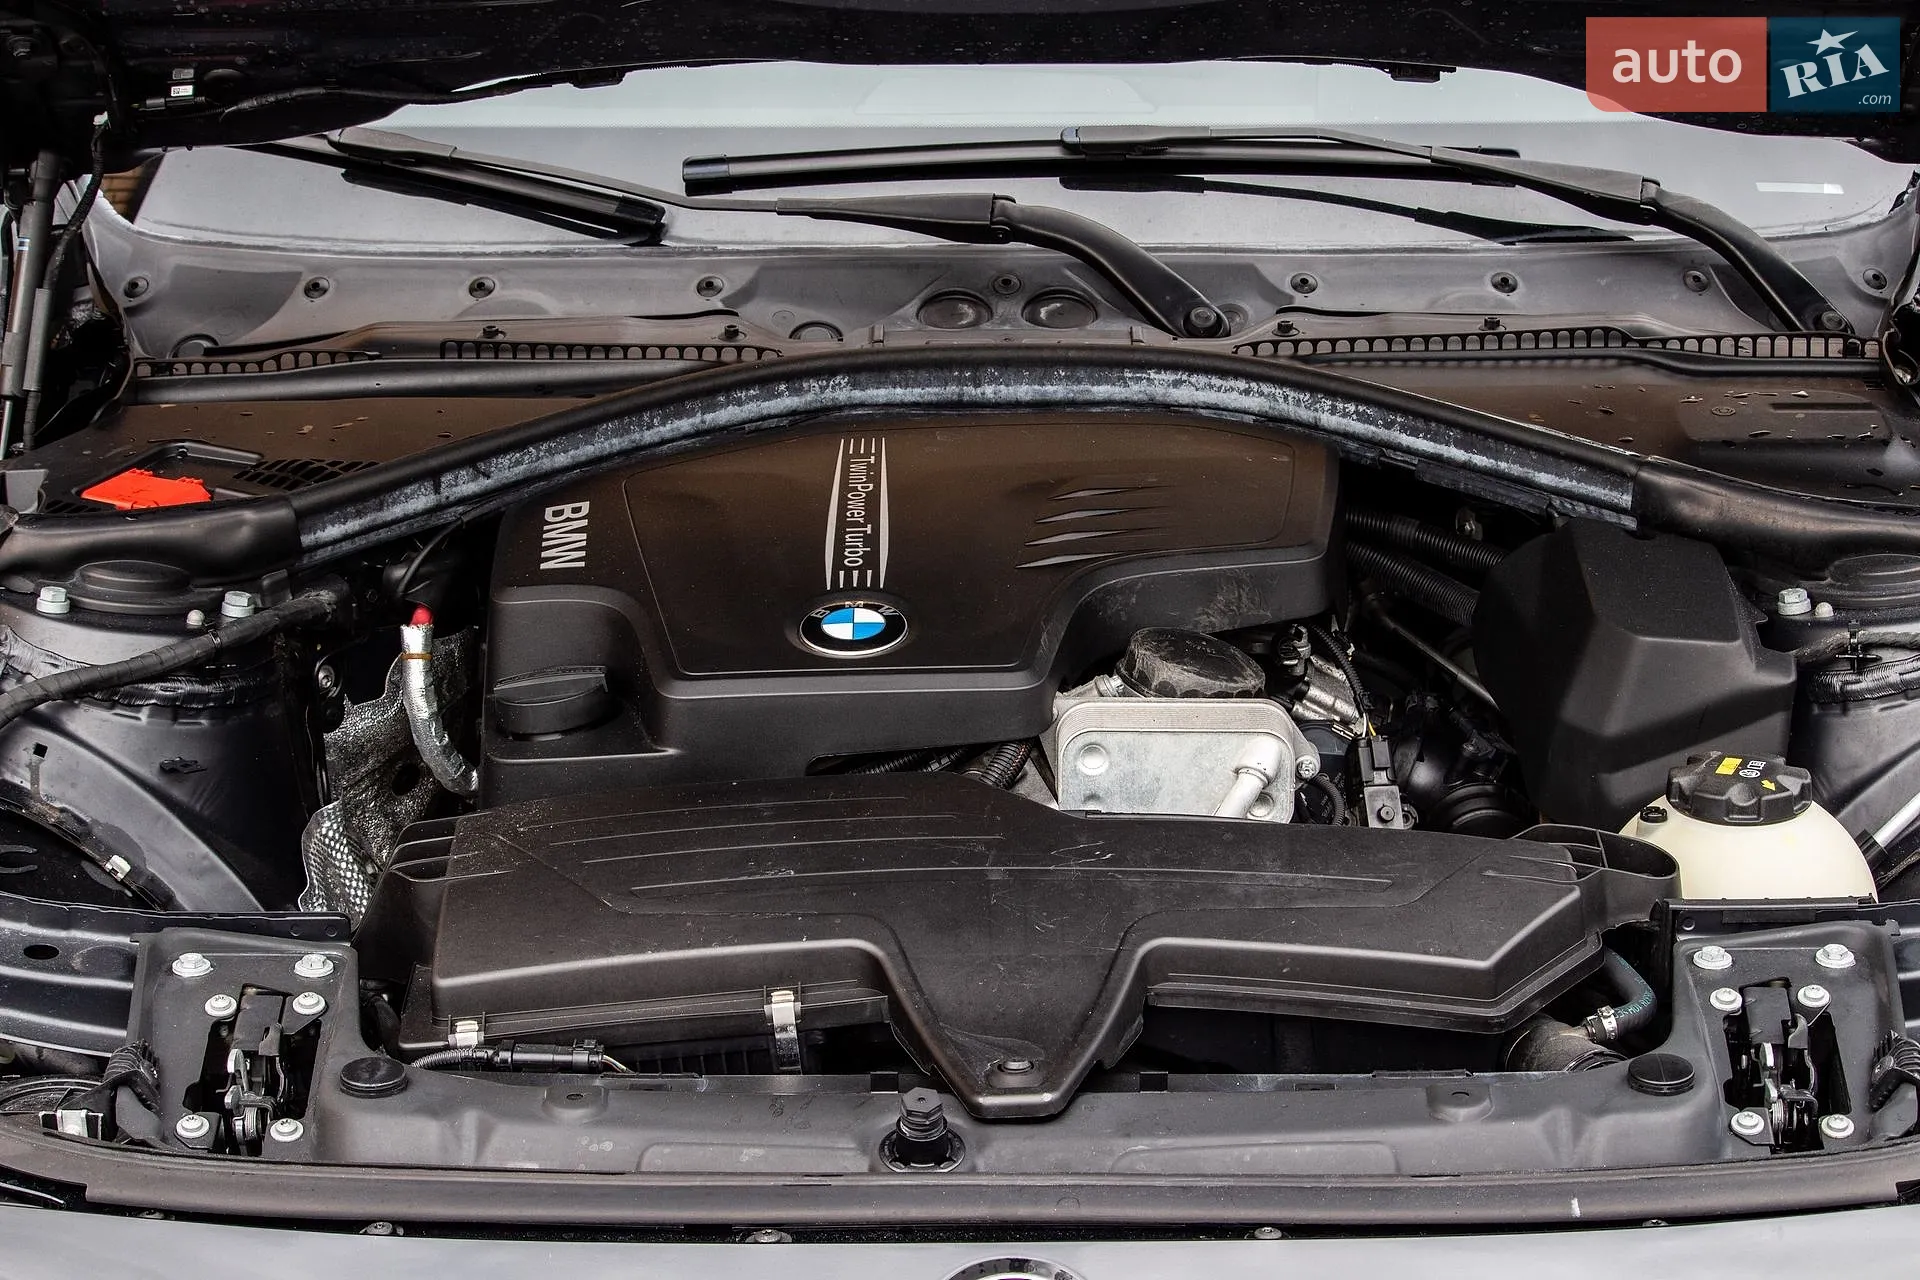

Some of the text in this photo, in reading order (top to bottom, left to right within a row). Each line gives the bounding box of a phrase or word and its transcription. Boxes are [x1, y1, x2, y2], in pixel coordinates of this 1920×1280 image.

[540, 501, 590, 569] BMW
[843, 455, 876, 567] TwinPower Turbo
[810, 600, 900, 619] BMW
